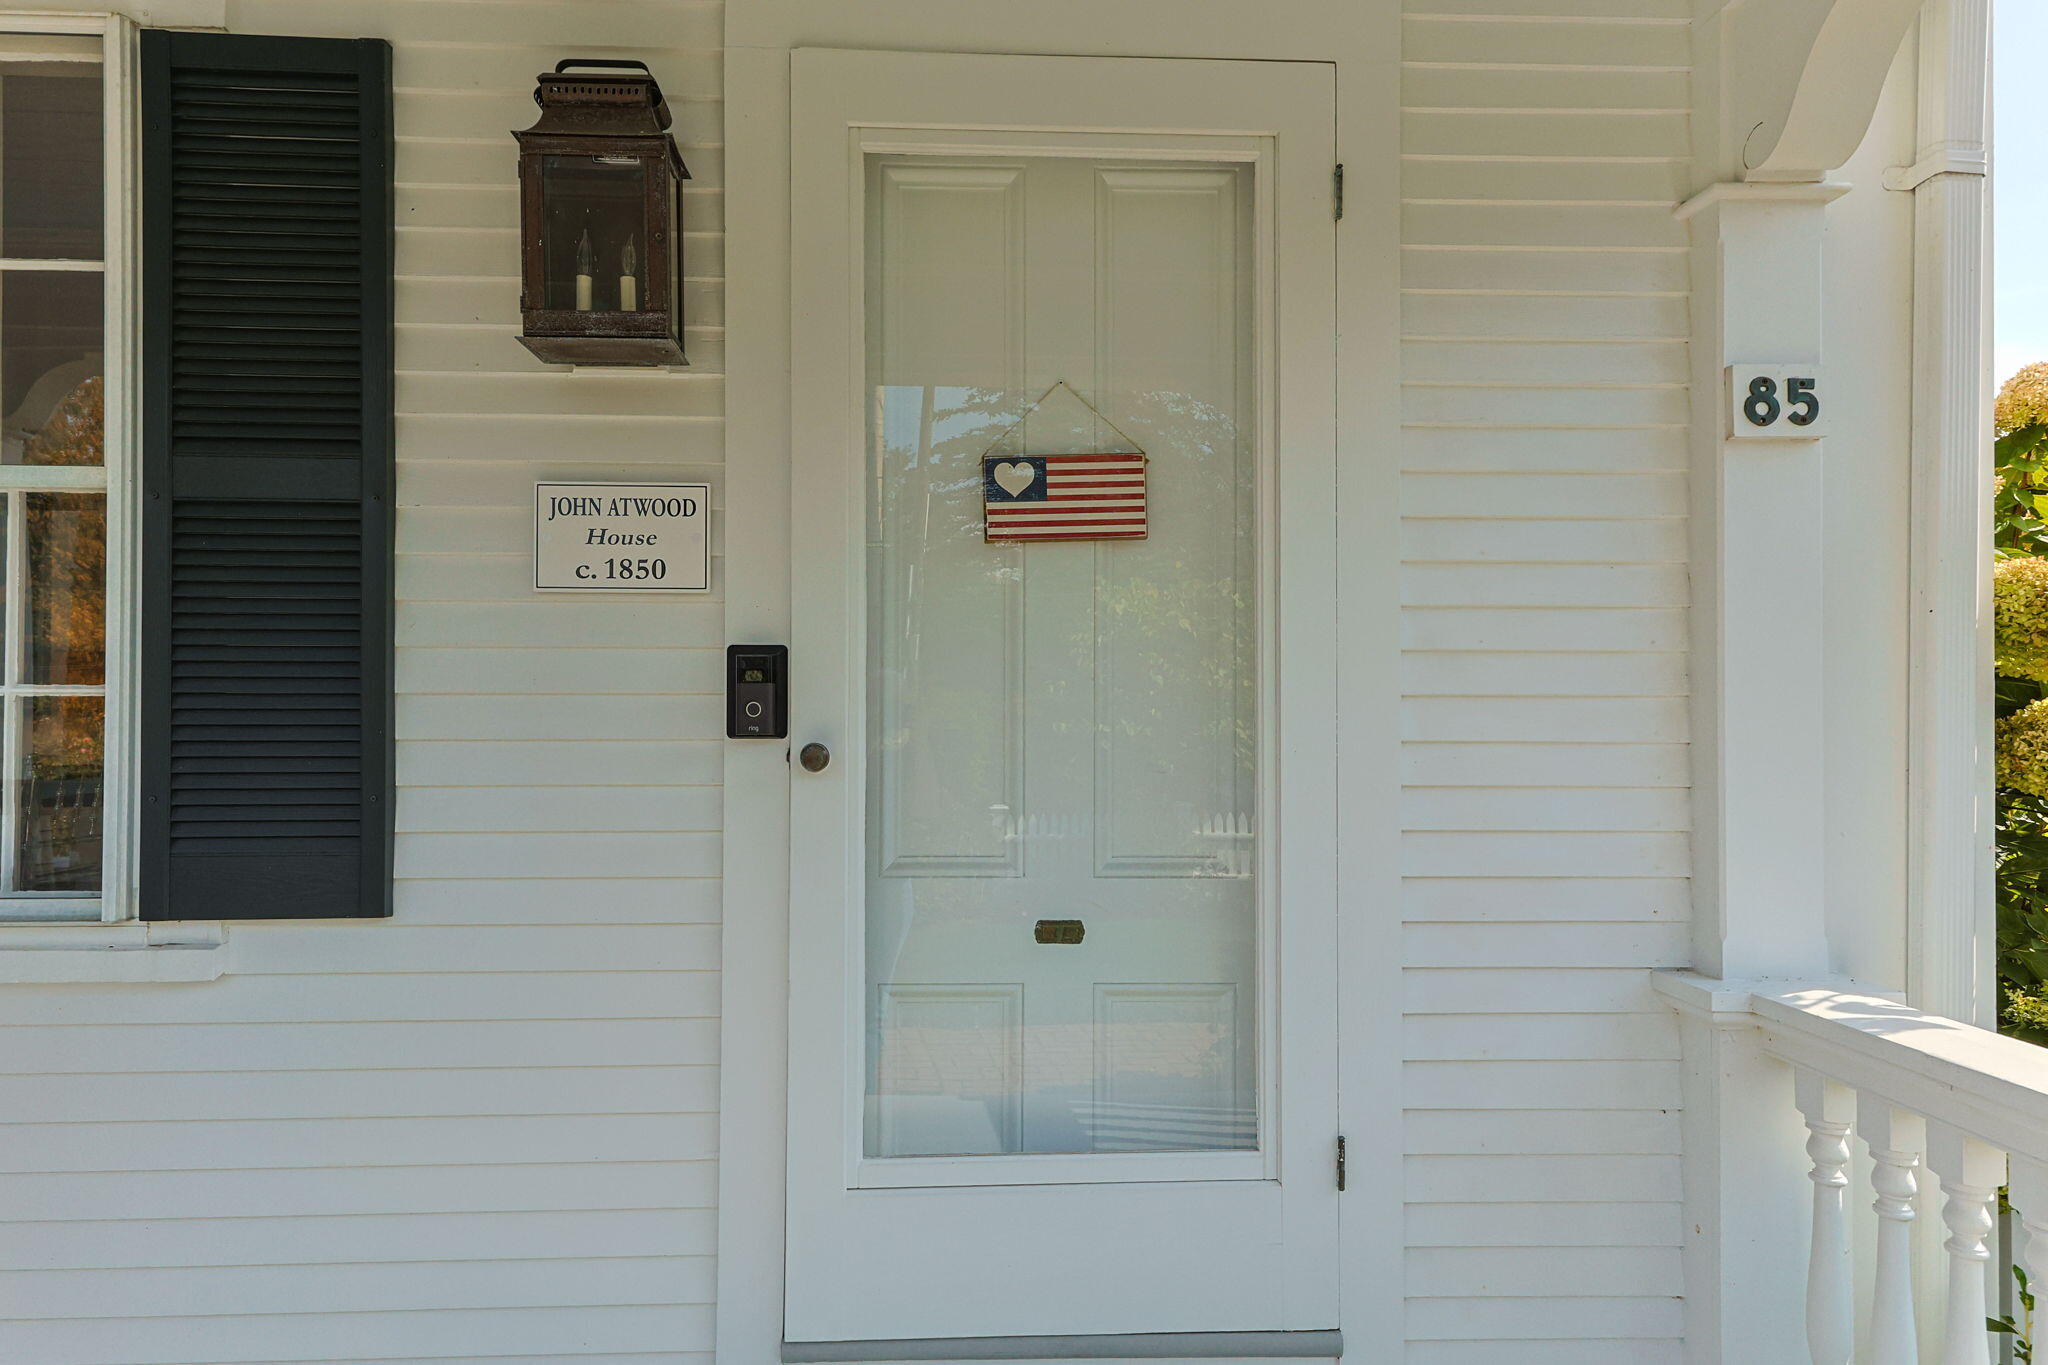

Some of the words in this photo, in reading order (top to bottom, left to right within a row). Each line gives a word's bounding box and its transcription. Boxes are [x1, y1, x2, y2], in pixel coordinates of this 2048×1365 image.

[1743, 376, 1820, 427] 85
[548, 497, 603, 521] JOHN
[607, 497, 697, 518] ATWOOD
[585, 528, 658, 546] House
[575, 564, 597, 580] c.
[604, 558, 667, 580] 1850
[748, 725, 760, 733] ring
